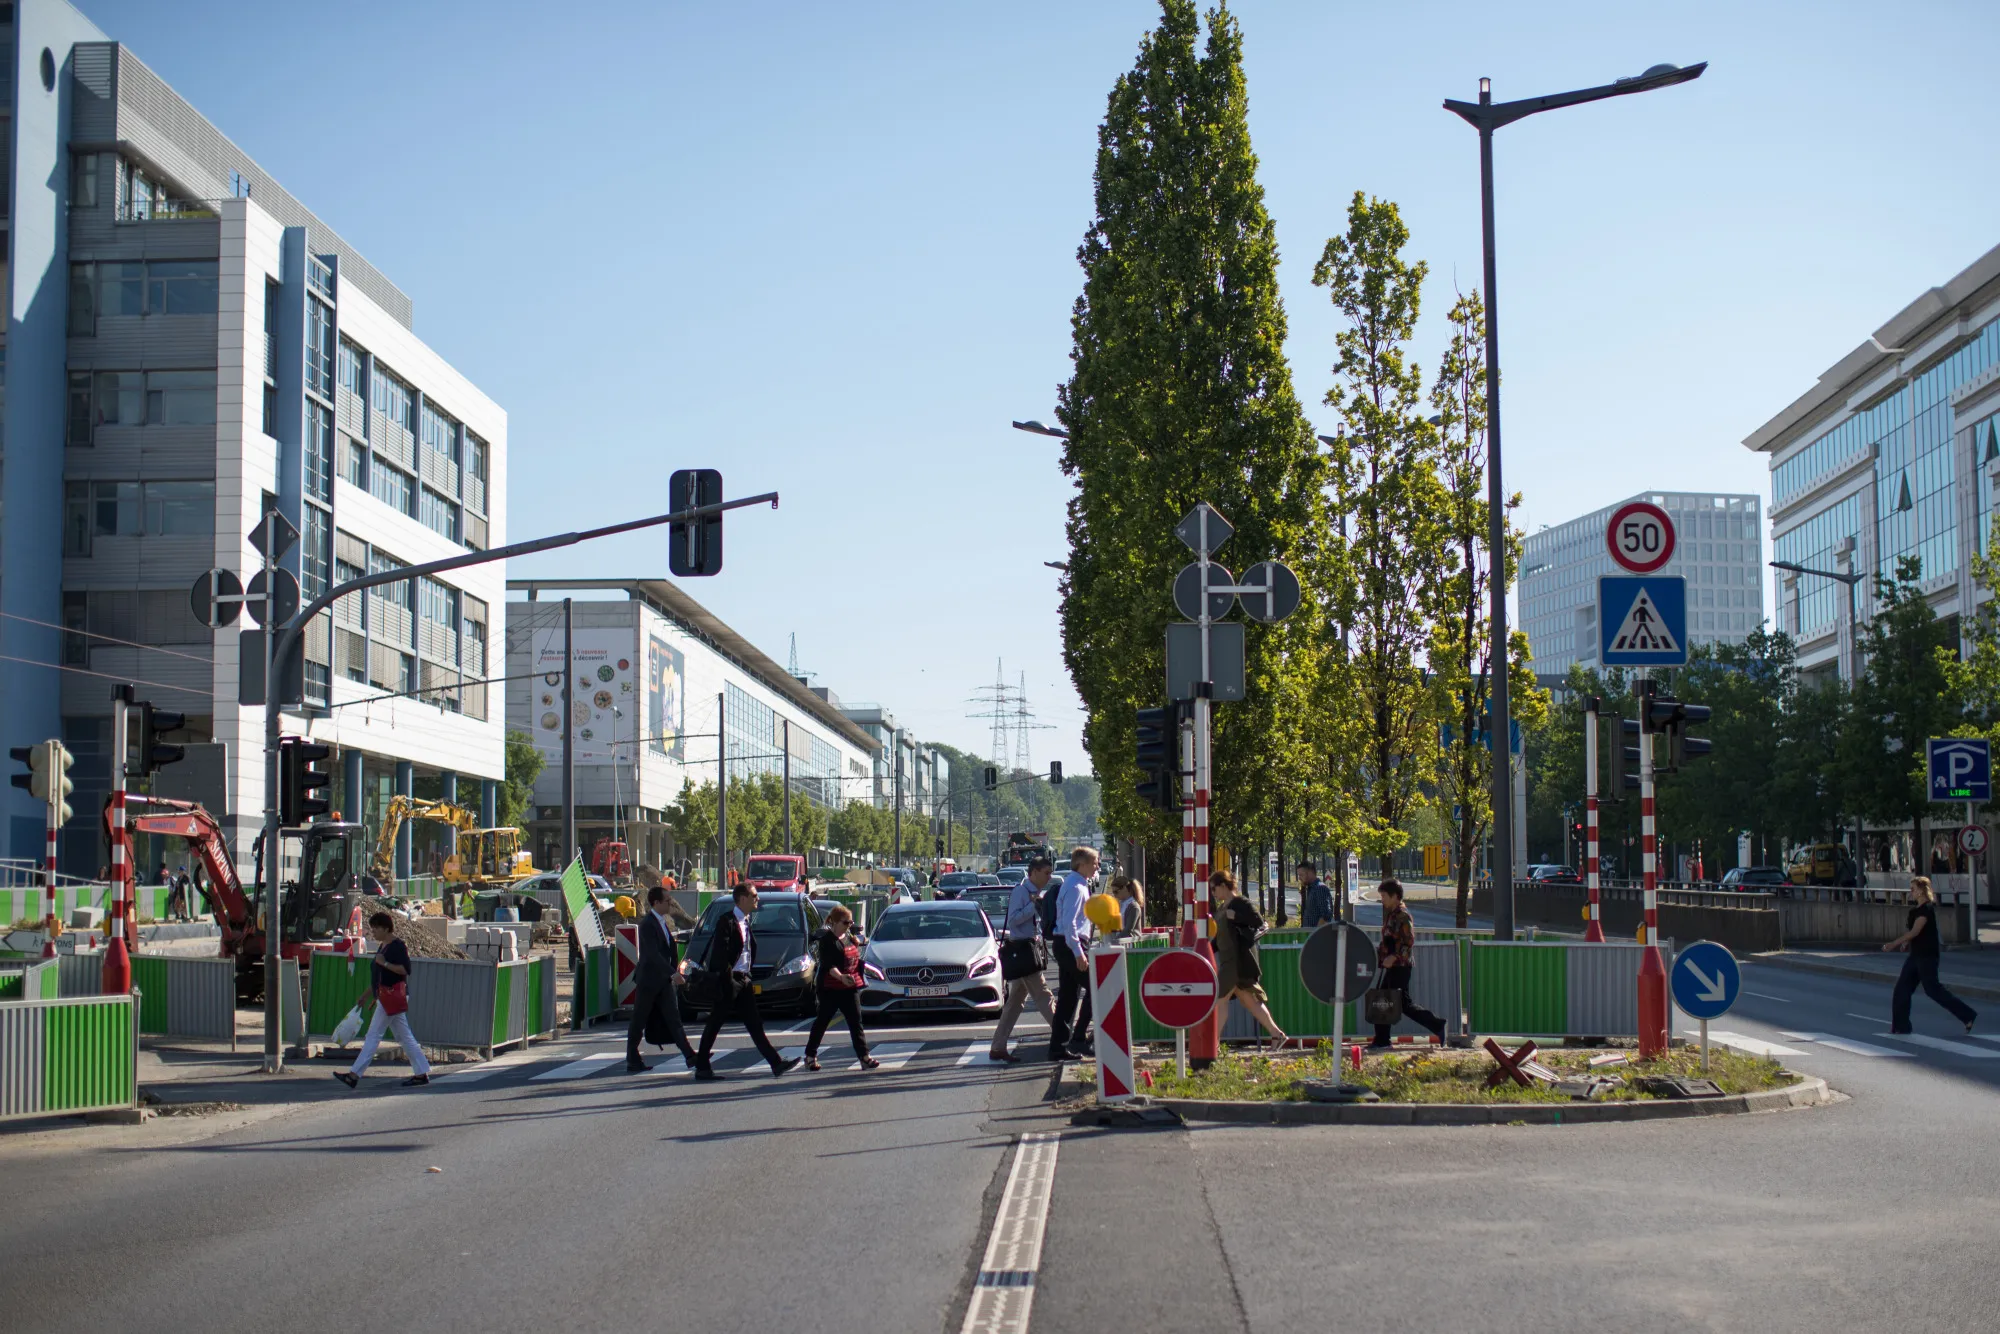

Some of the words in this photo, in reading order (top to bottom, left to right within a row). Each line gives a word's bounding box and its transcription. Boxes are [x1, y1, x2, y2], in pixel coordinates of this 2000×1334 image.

[1623, 523, 1659, 553] 50
[1949, 752, 1974, 788] P
[1950, 789, 1971, 797] LIBRE
